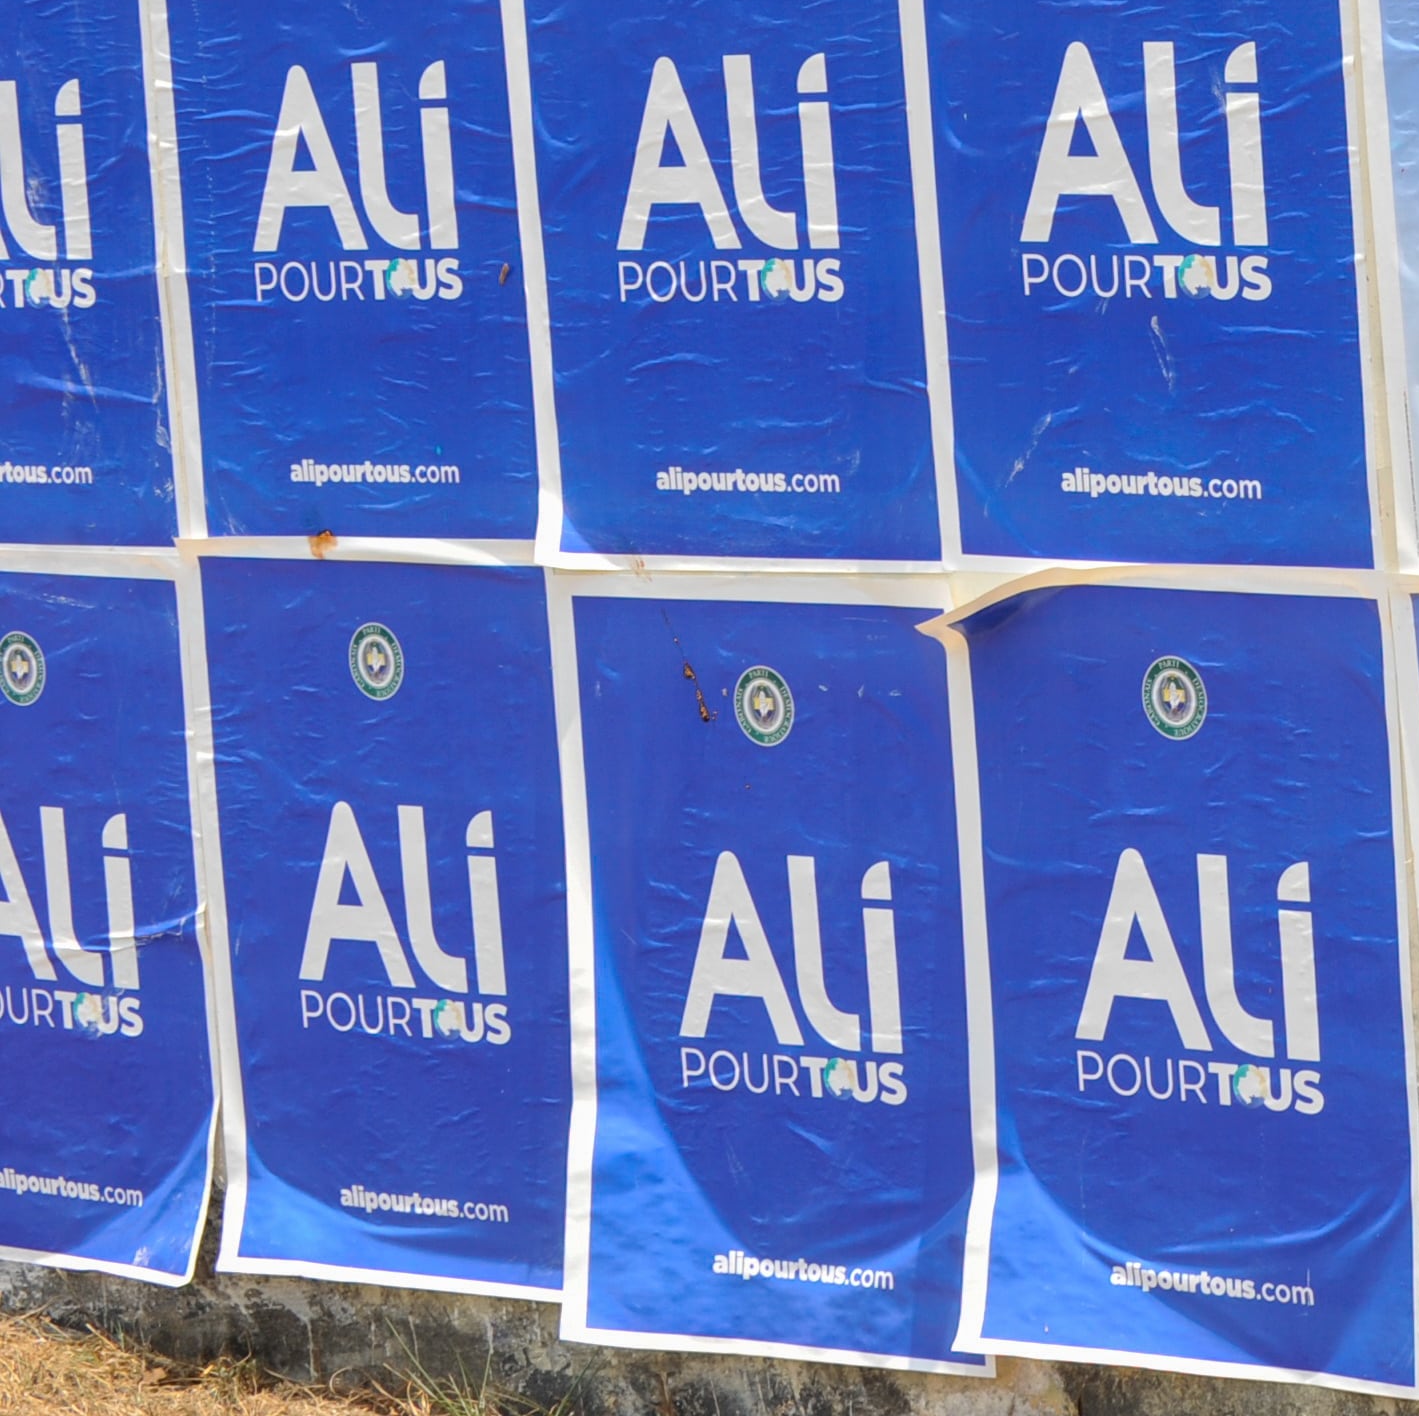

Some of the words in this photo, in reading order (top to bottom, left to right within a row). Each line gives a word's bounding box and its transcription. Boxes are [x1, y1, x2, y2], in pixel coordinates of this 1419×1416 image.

[289, 457, 461, 488] alipourtous.com
[655, 465, 841, 497] alipourtous.com
[1060, 466, 1262, 503] alipourtous.com
[339, 1184, 510, 1224] alipourtous.com
[711, 1248, 895, 1290] alipourtous.com
[1109, 1261, 1316, 1307] alipourtous.com
